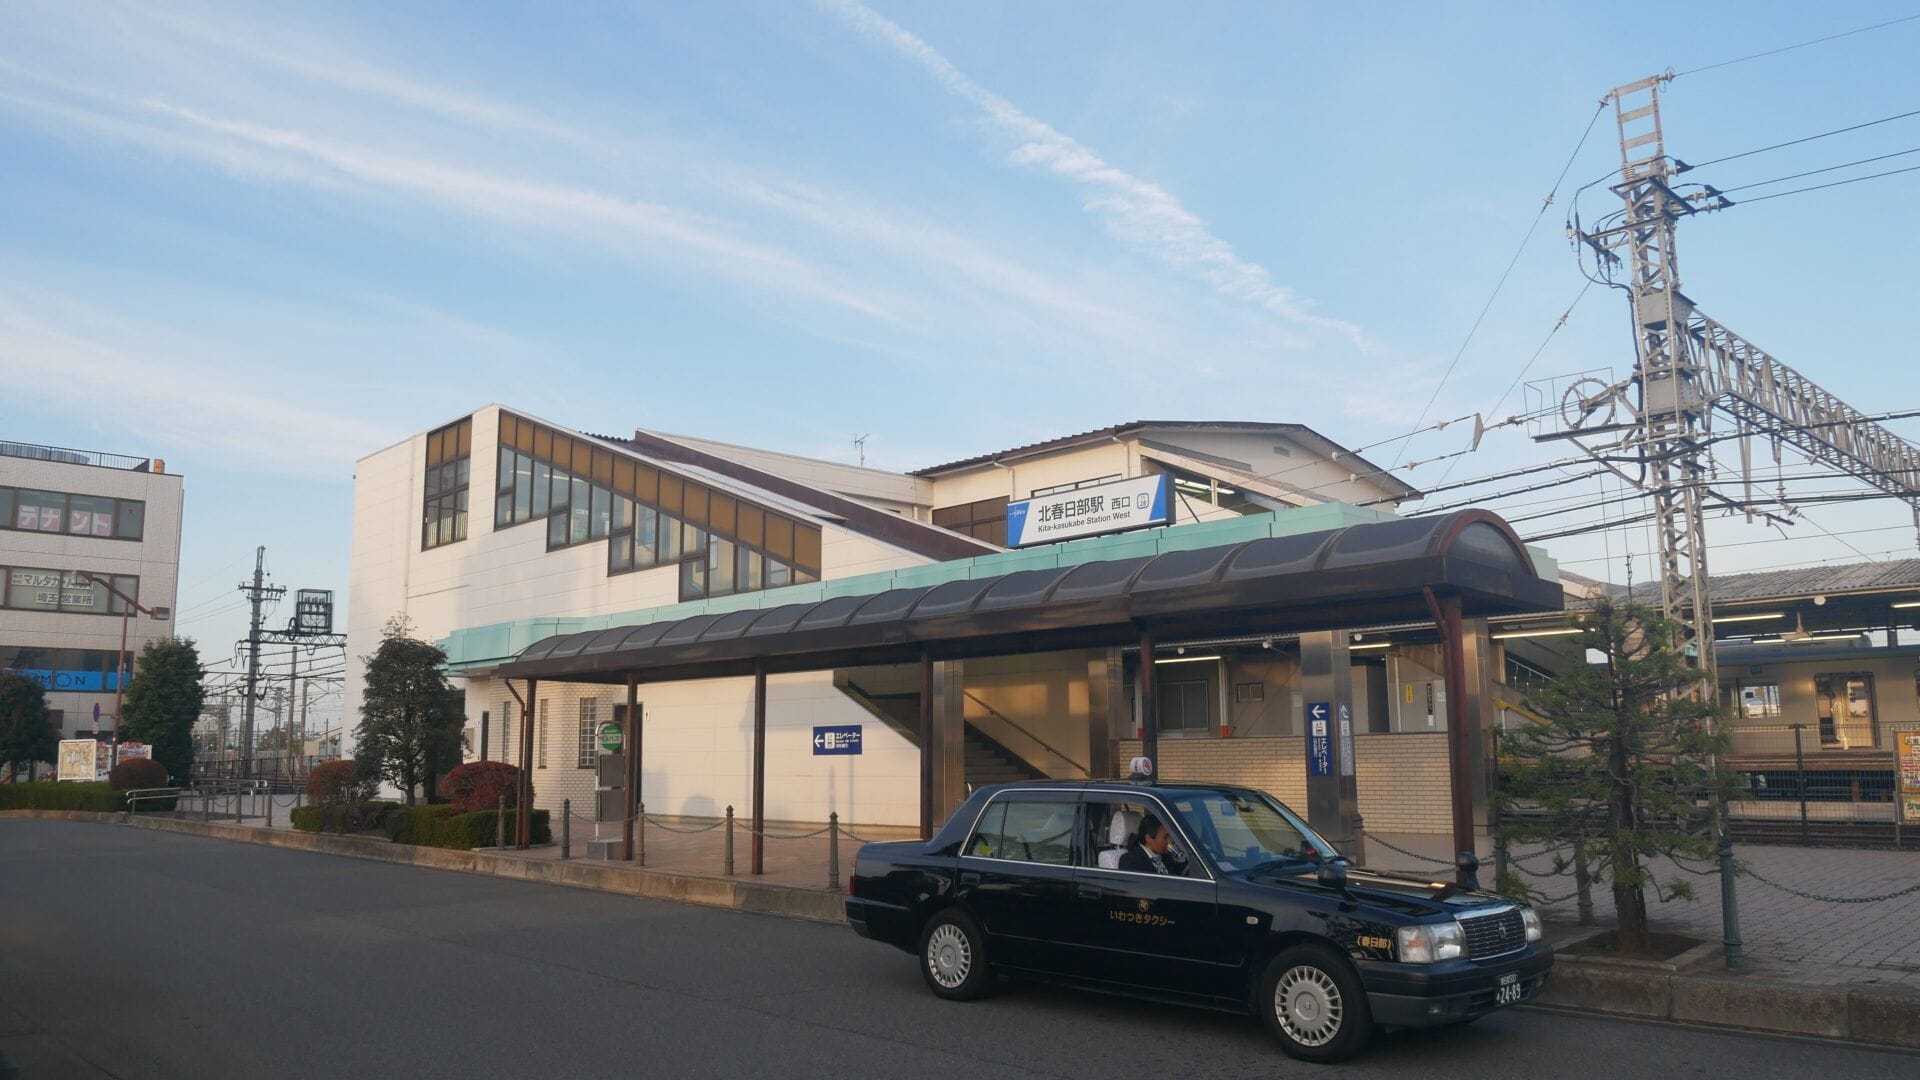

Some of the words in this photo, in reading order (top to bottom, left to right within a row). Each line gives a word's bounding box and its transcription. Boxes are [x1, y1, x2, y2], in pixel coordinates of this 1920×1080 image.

[18, 505, 109, 535] テナント
[1038, 496, 1104, 523] 北春日部駅
[1111, 496, 1131, 510] 西口
[1038, 519, 1085, 533] Kita-kasukabe
[1086, 514, 1111, 525] Station
[1112, 511, 1131, 520] West
[1110, 910, 1176, 926] いわつきタクシー
